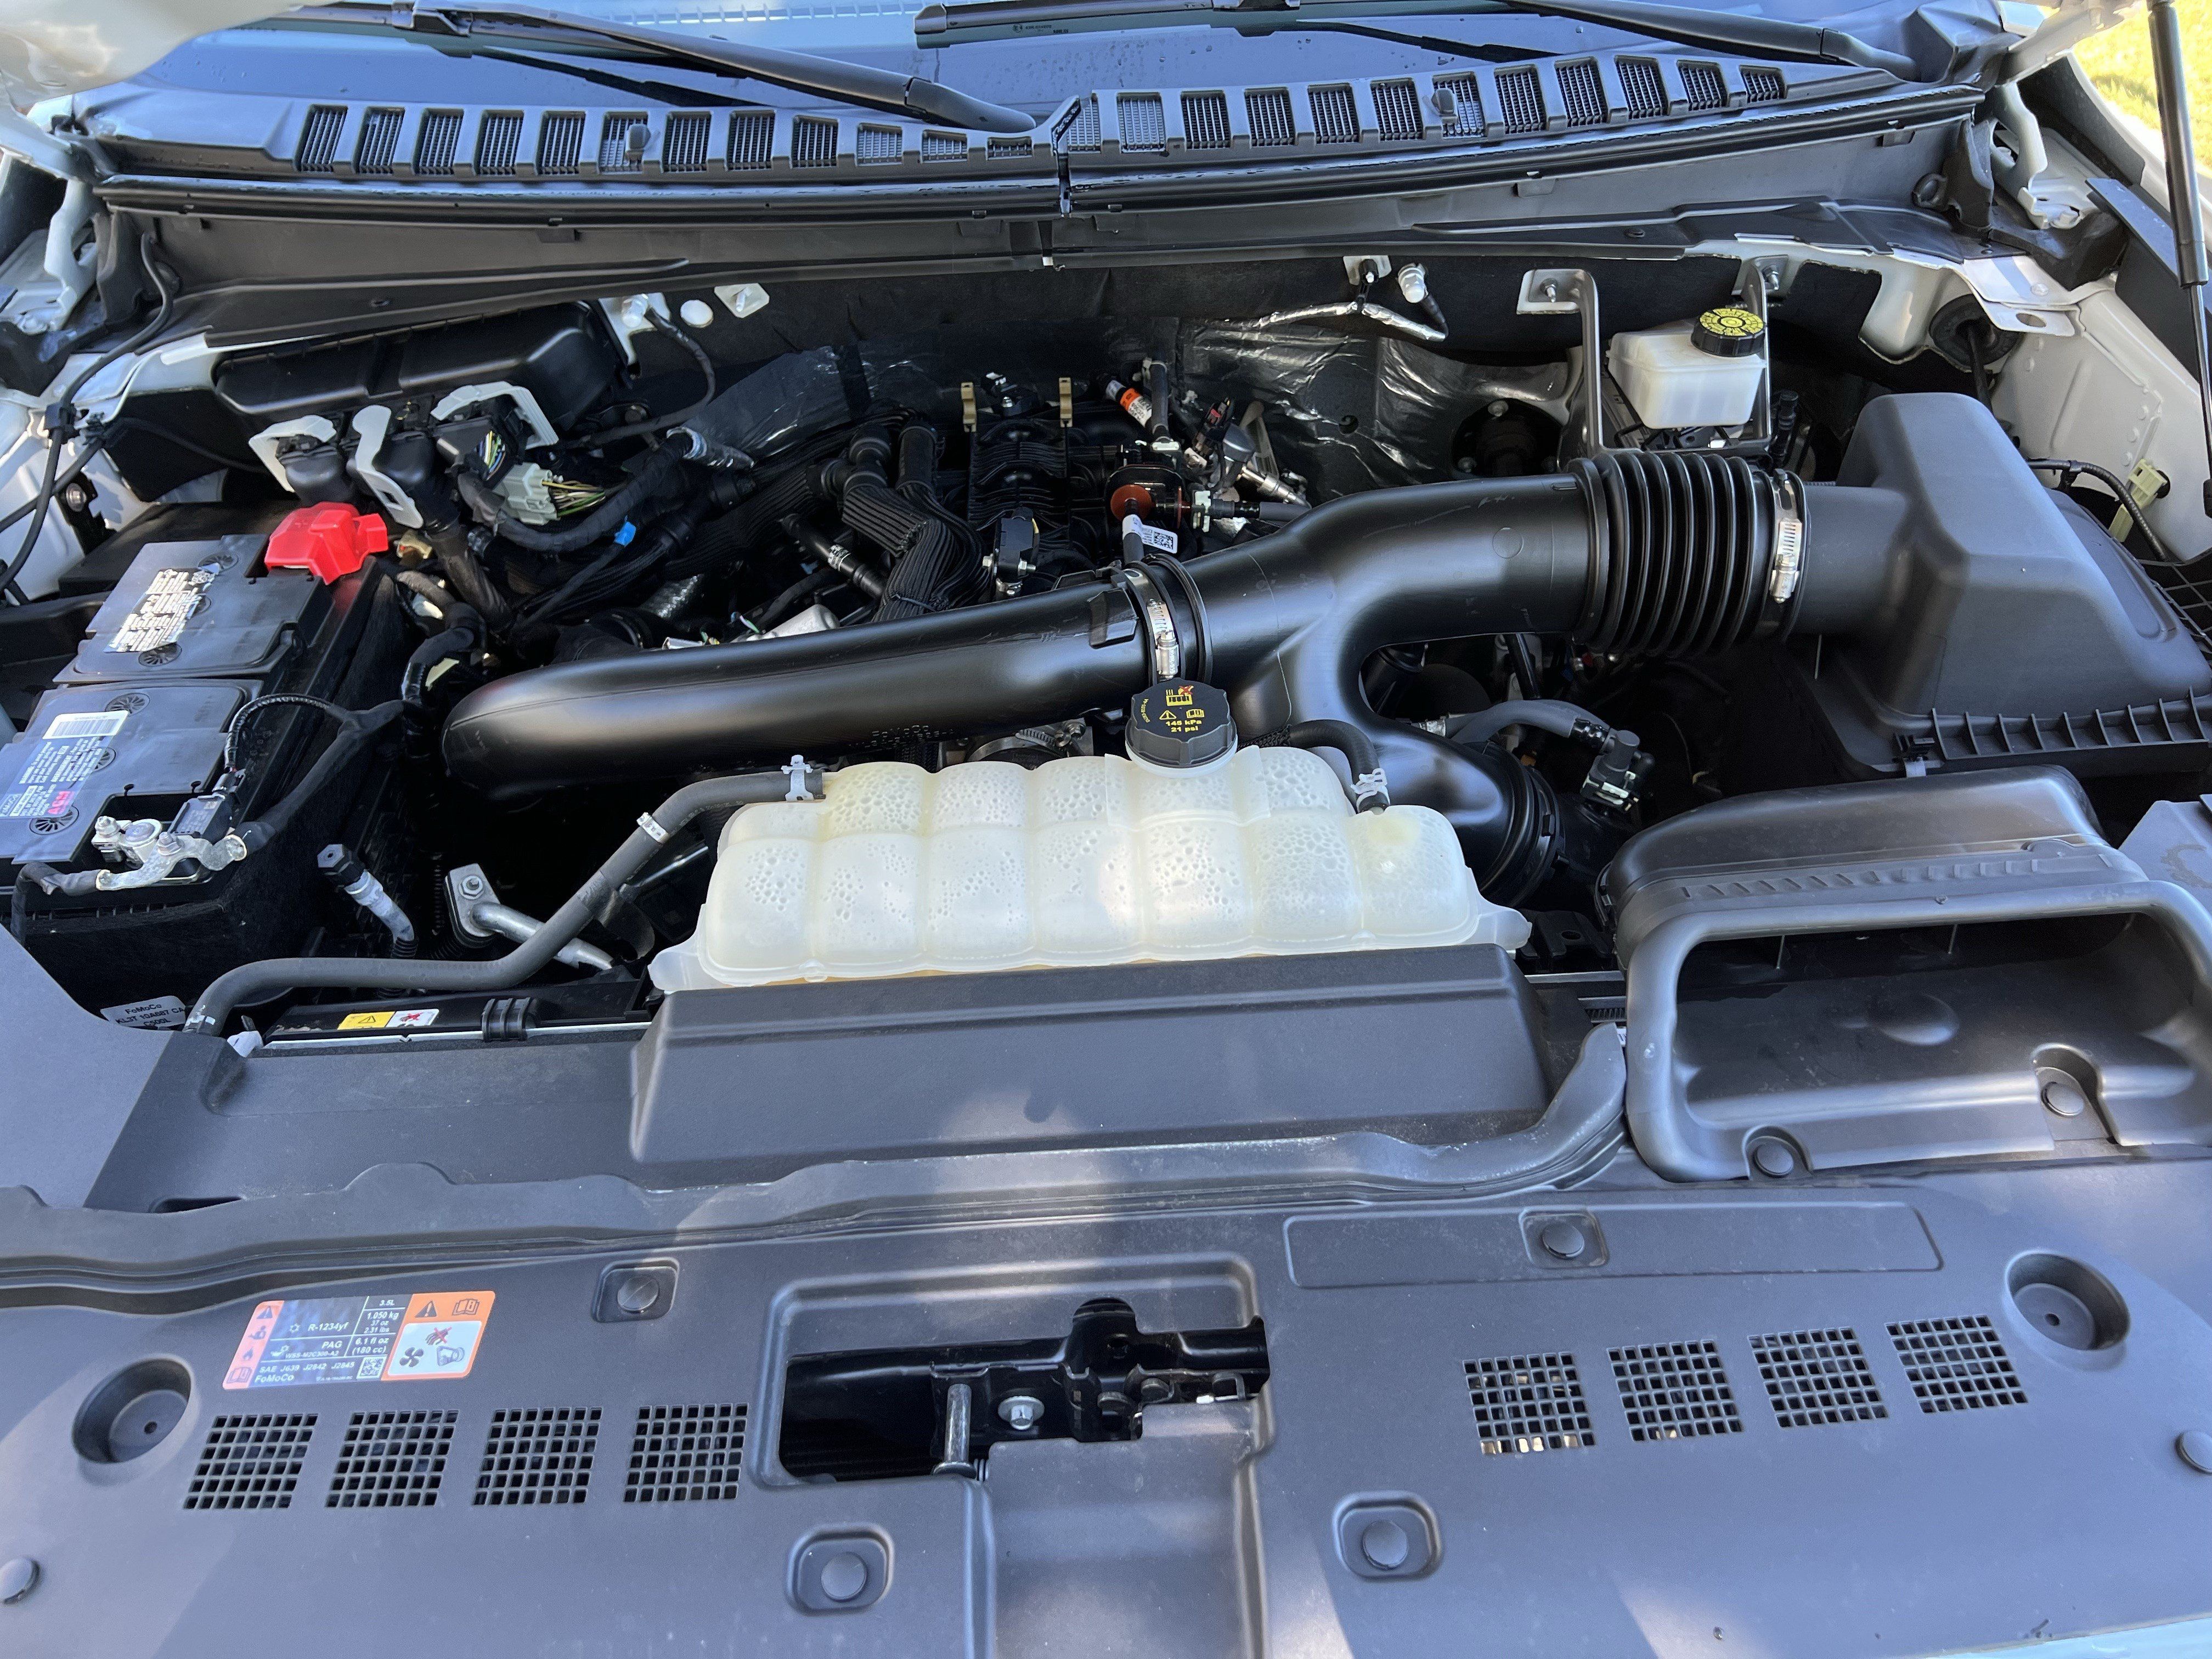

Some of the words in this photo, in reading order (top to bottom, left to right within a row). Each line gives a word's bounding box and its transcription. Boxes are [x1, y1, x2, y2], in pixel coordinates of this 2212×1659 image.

[125, 1004, 162, 1014] FoMoCo
[367, 1311, 388, 1320] 1.050
[388, 1311, 399, 1321] kg
[307, 1322, 349, 1333] R-1234yf
[321, 1340, 343, 1349] PAG
[355, 1337, 369, 1345] 6.1
[352, 1346, 371, 1355] (180
[373, 1345, 387, 1354] cc)
[303, 1363, 327, 1371] J2842
[331, 1361, 356, 1369] J2845
[254, 1373, 295, 1383] FoMoCo
